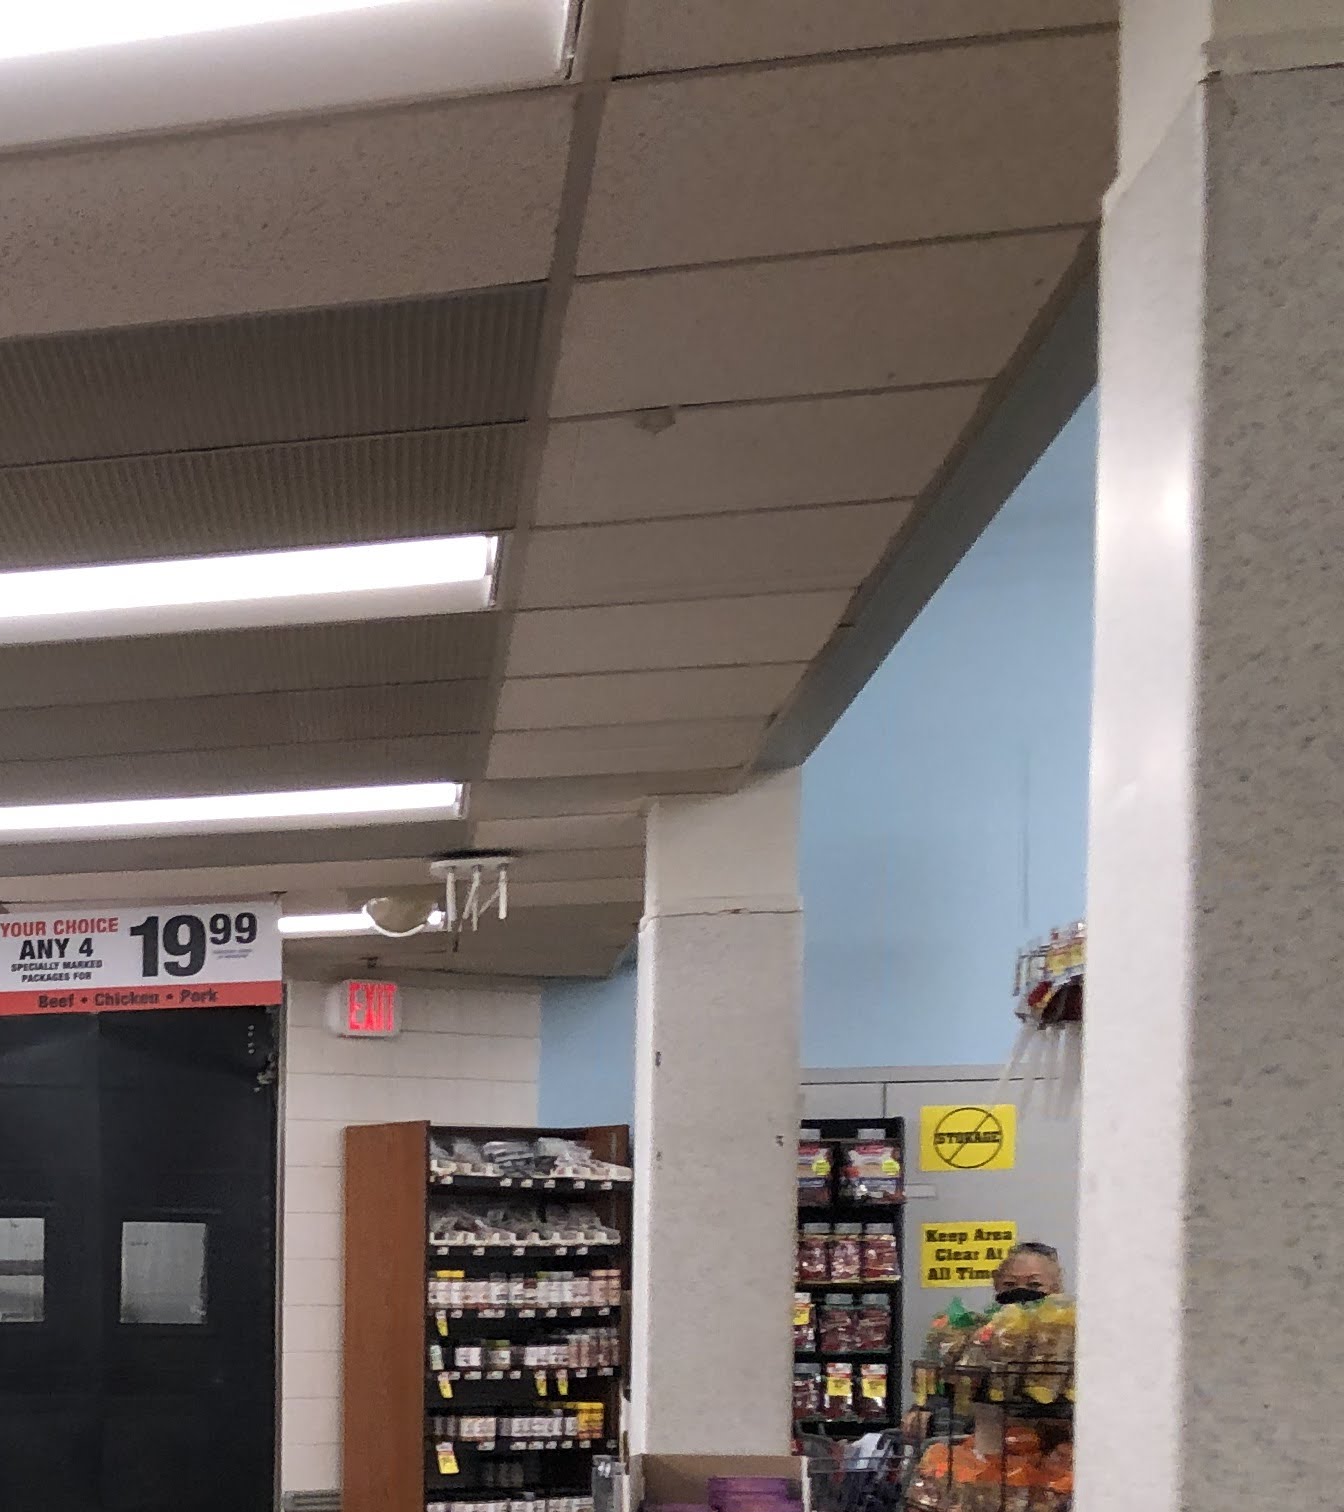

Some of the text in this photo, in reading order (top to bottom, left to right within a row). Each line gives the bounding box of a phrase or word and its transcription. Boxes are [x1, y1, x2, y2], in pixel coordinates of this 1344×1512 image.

[0, 917, 118, 938] YOUR CHOICE
[19, 938, 93, 960] ANY 4
[11, 959, 103, 973] SPECIALLY MARKED
[21, 971, 92, 983] PACKAGES FOR
[38, 988, 218, 1008] Beef Chicken Pork
[349, 983, 396, 1031] EXIT
[934, 1131, 1001, 1144] STORAGE
[925, 1228, 1012, 1244] Keep Area
[935, 1247, 1003, 1262] Clear At
[928, 1267, 951, 1281] All
